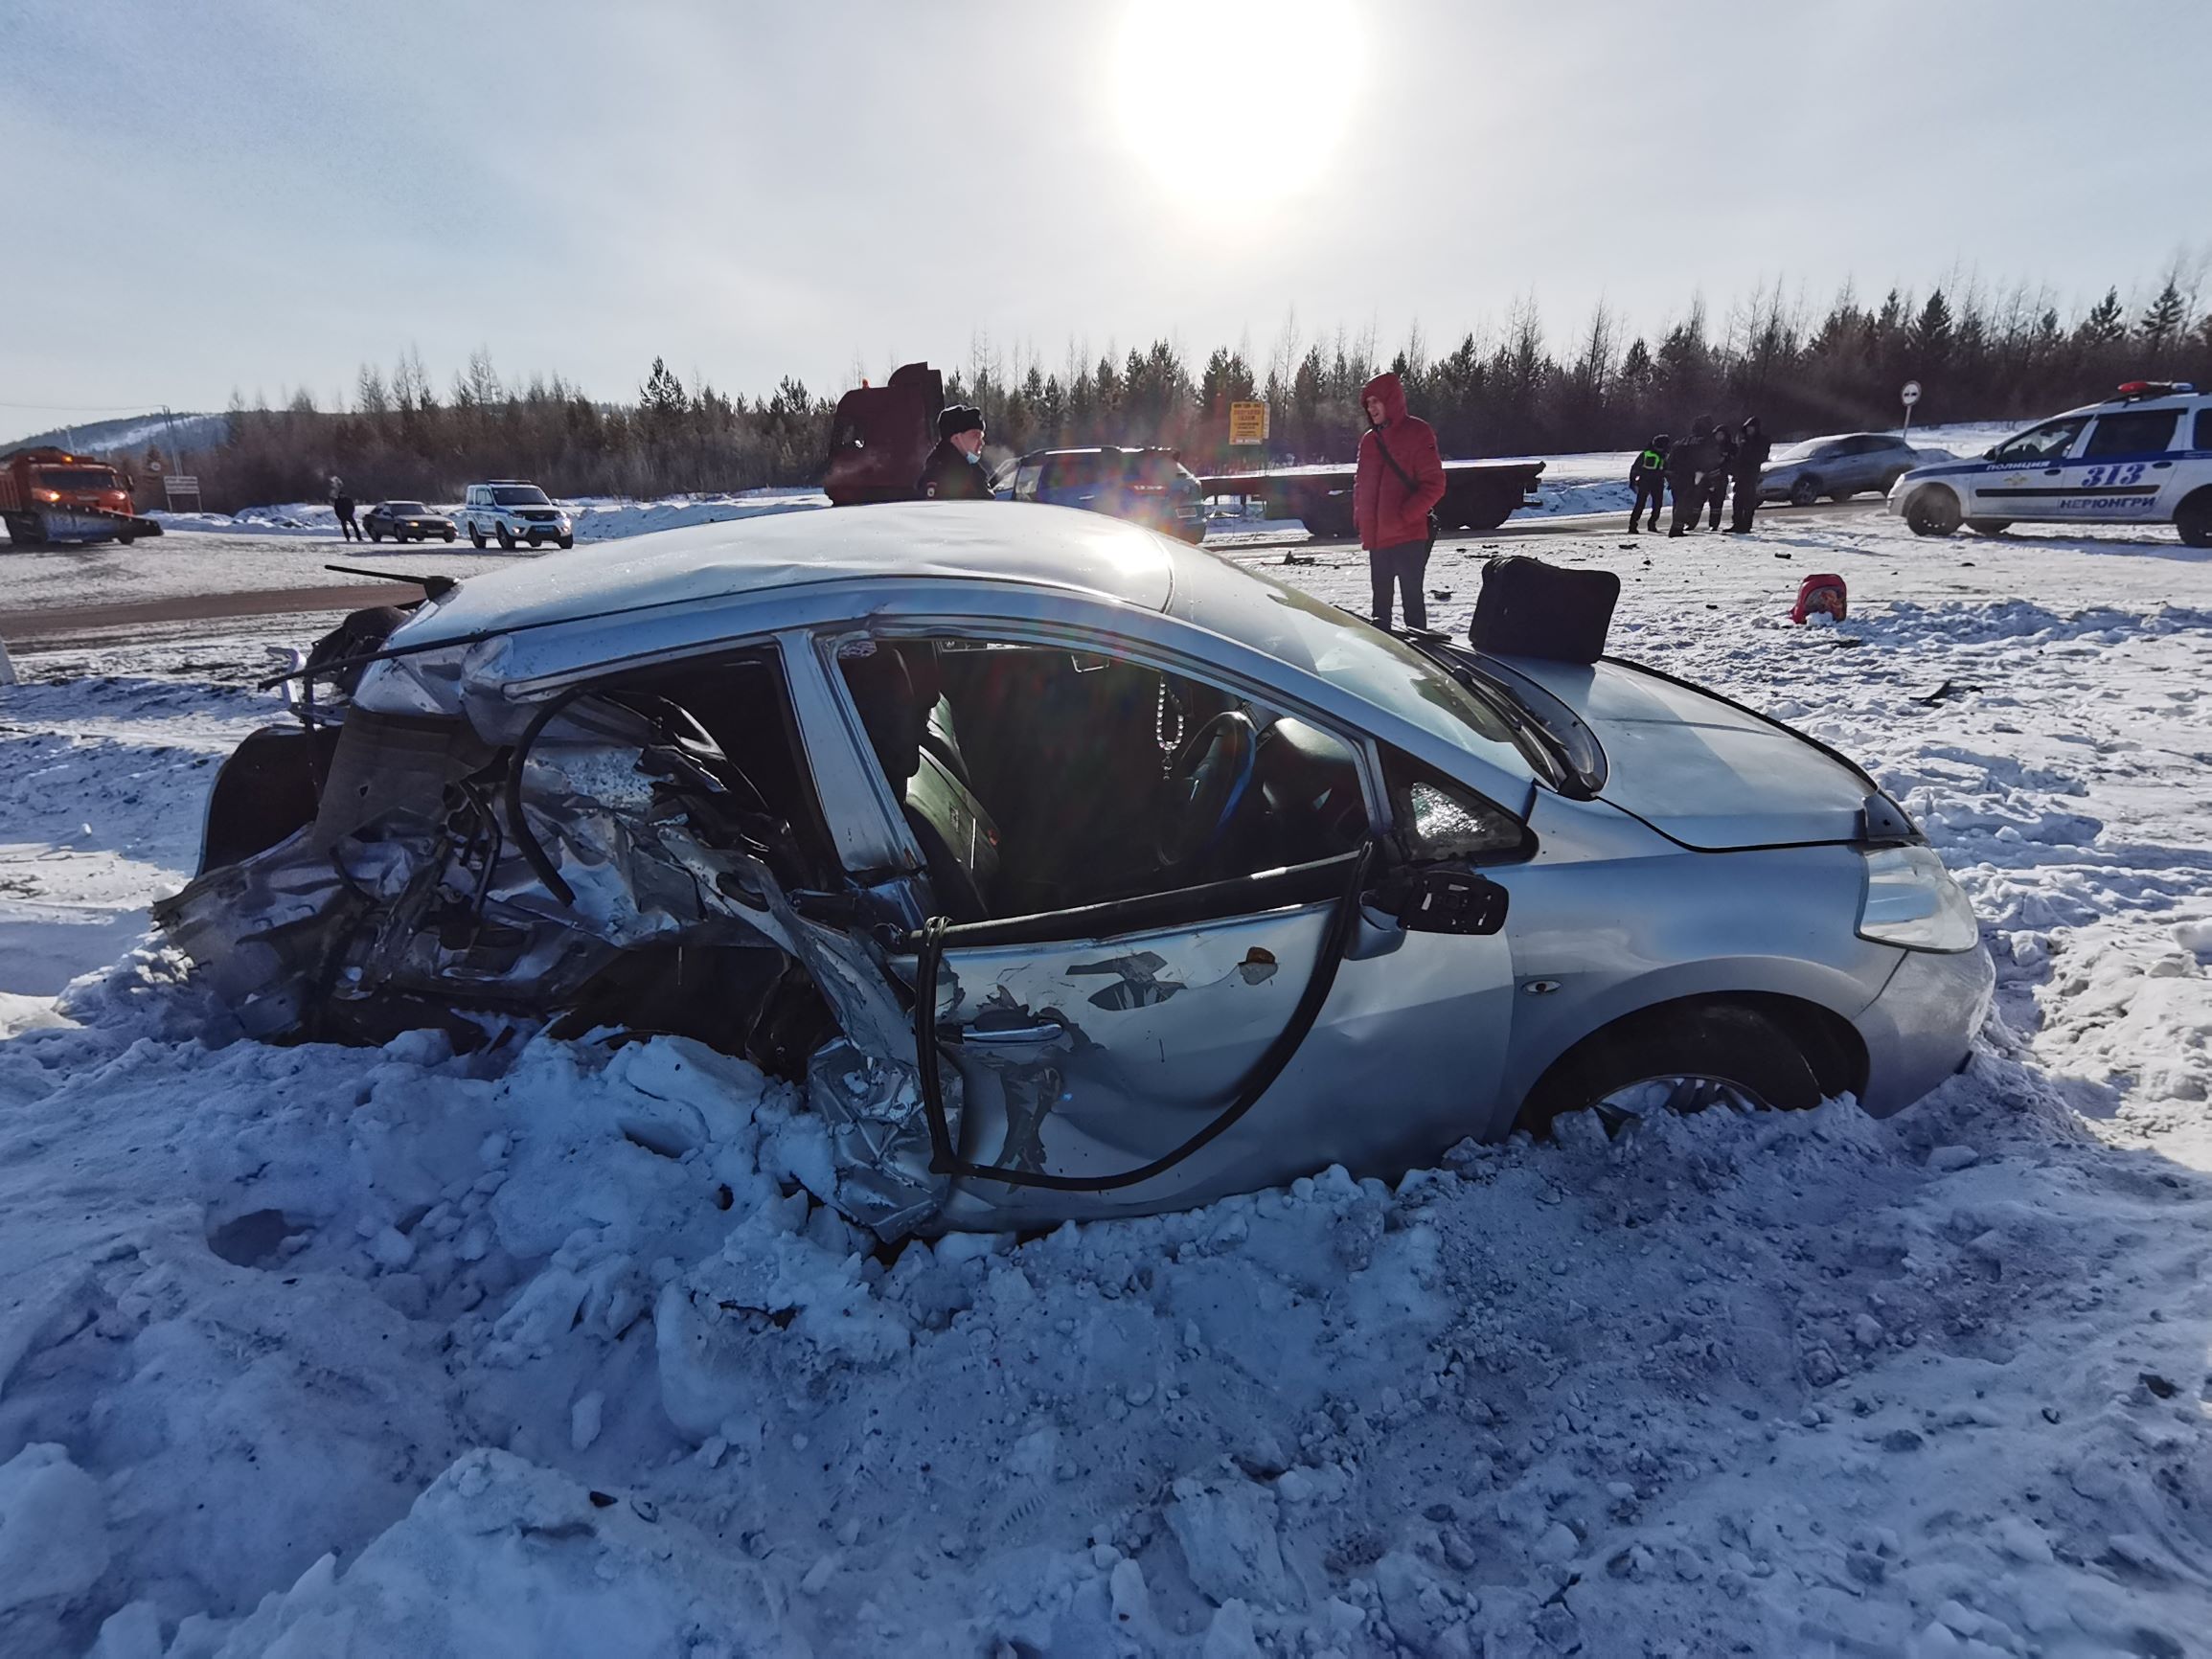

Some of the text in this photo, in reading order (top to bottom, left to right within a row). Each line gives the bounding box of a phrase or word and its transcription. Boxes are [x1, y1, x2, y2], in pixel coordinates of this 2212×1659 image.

[1986, 461, 2050, 471] ПОЛИЦИЯ
[2081, 464, 2146, 488] 313
[2060, 497, 2156, 509] НЕРЮНГРИ
